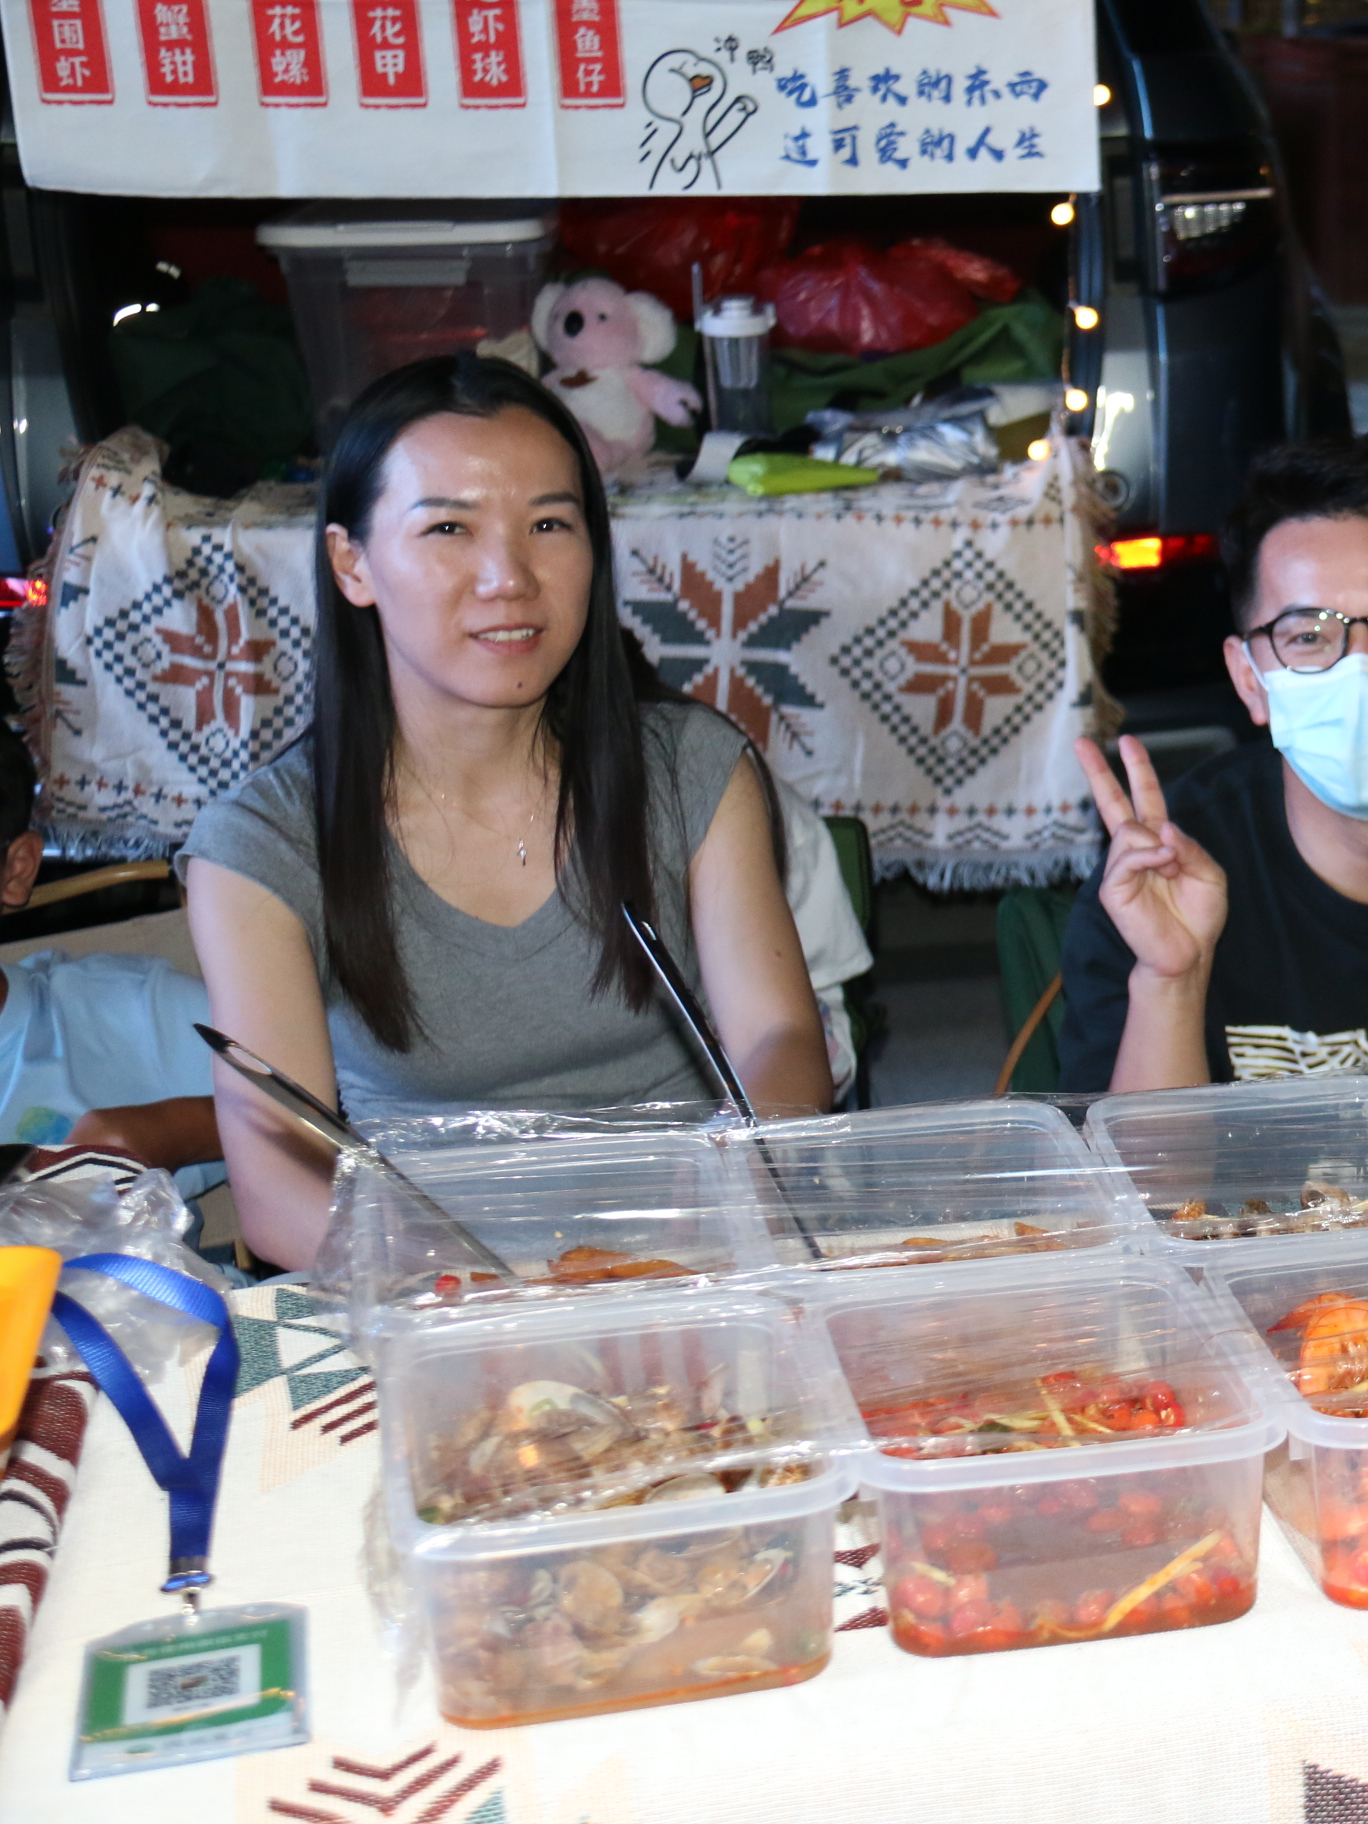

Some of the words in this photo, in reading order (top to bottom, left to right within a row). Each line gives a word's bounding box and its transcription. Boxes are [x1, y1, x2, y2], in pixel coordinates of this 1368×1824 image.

[154, 3, 196, 84] 蟹钳
[266, 5, 310, 85] 花螺
[367, 7, 406, 86] 花甲
[467, 0, 509, 87] 虾球
[714, 34, 775, 75] 冲鸭
[775, 67, 1049, 110] 吃喜欢的东西
[779, 121, 1047, 170] 过可爱的人生
